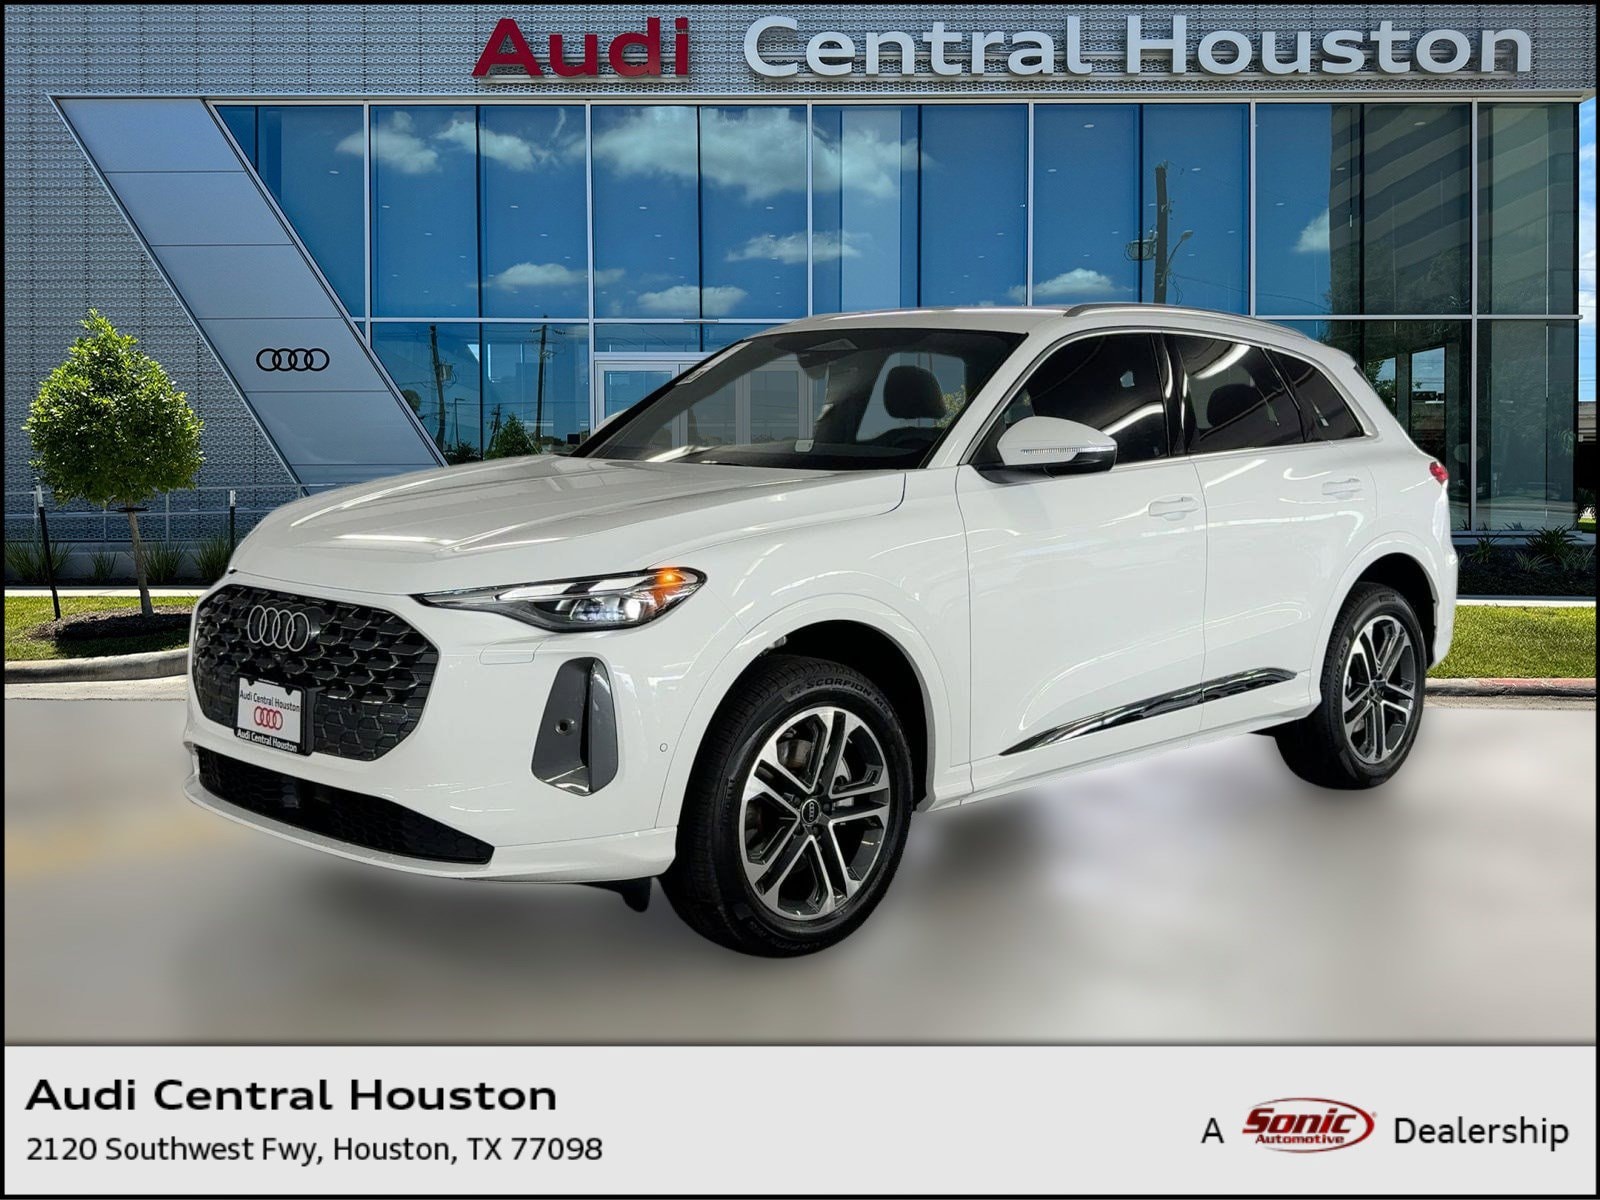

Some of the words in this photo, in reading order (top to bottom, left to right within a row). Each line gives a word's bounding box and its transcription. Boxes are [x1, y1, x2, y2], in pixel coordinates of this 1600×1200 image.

[471, 16, 690, 78] Audi
[743, 15, 1093, 78] Central
[1125, 14, 1532, 76] Houston
[806, 677, 872, 698] SCORPION
[240, 690, 252, 701] Audi
[253, 692, 274, 706] Central
[275, 698, 300, 712] Houston
[237, 729, 250, 739] Audi
[252, 732, 272, 746] Central
[273, 738, 297, 752] Houston
